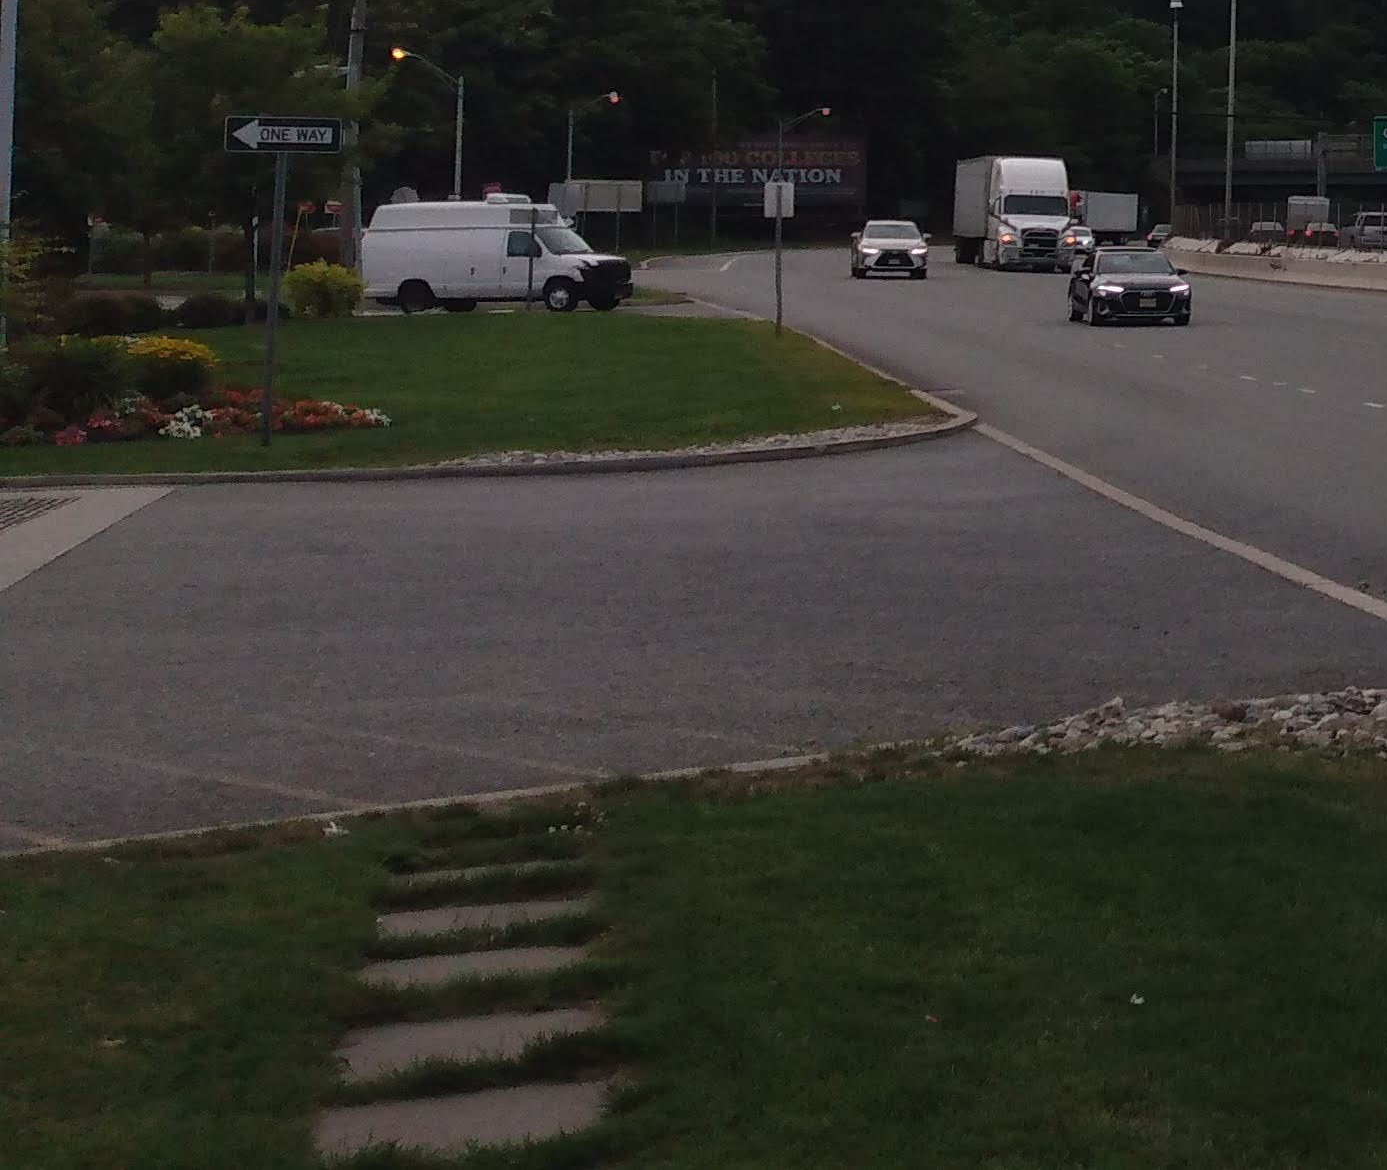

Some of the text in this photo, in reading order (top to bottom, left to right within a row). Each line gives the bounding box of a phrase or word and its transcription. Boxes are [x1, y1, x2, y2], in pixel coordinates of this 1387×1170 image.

[260, 129, 327, 142] ONE WAY
[664, 168, 842, 183] IN THE NATION
